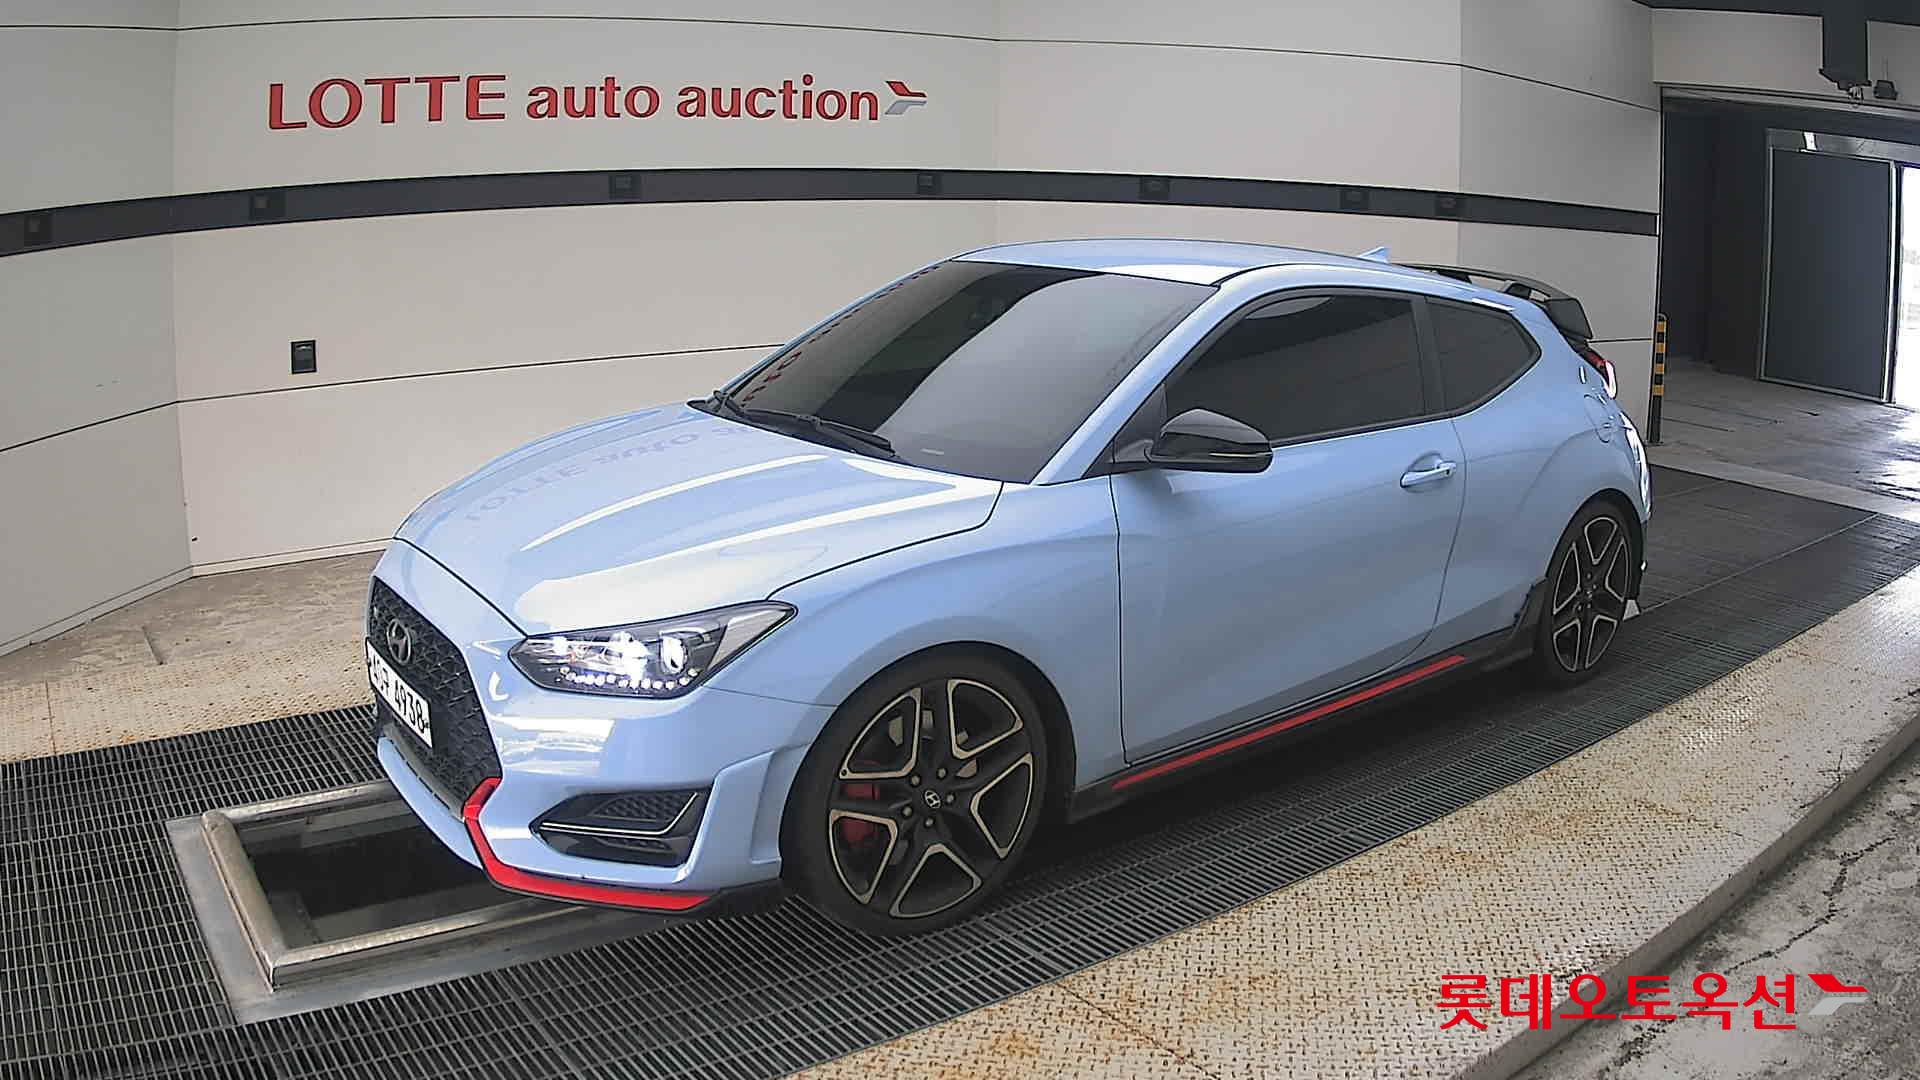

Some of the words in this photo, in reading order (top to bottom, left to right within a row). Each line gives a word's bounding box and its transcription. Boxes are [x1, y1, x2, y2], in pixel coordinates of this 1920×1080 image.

[268, 74, 506, 130] LOTTE
[526, 76, 661, 119] auto
[676, 74, 880, 121] auction
